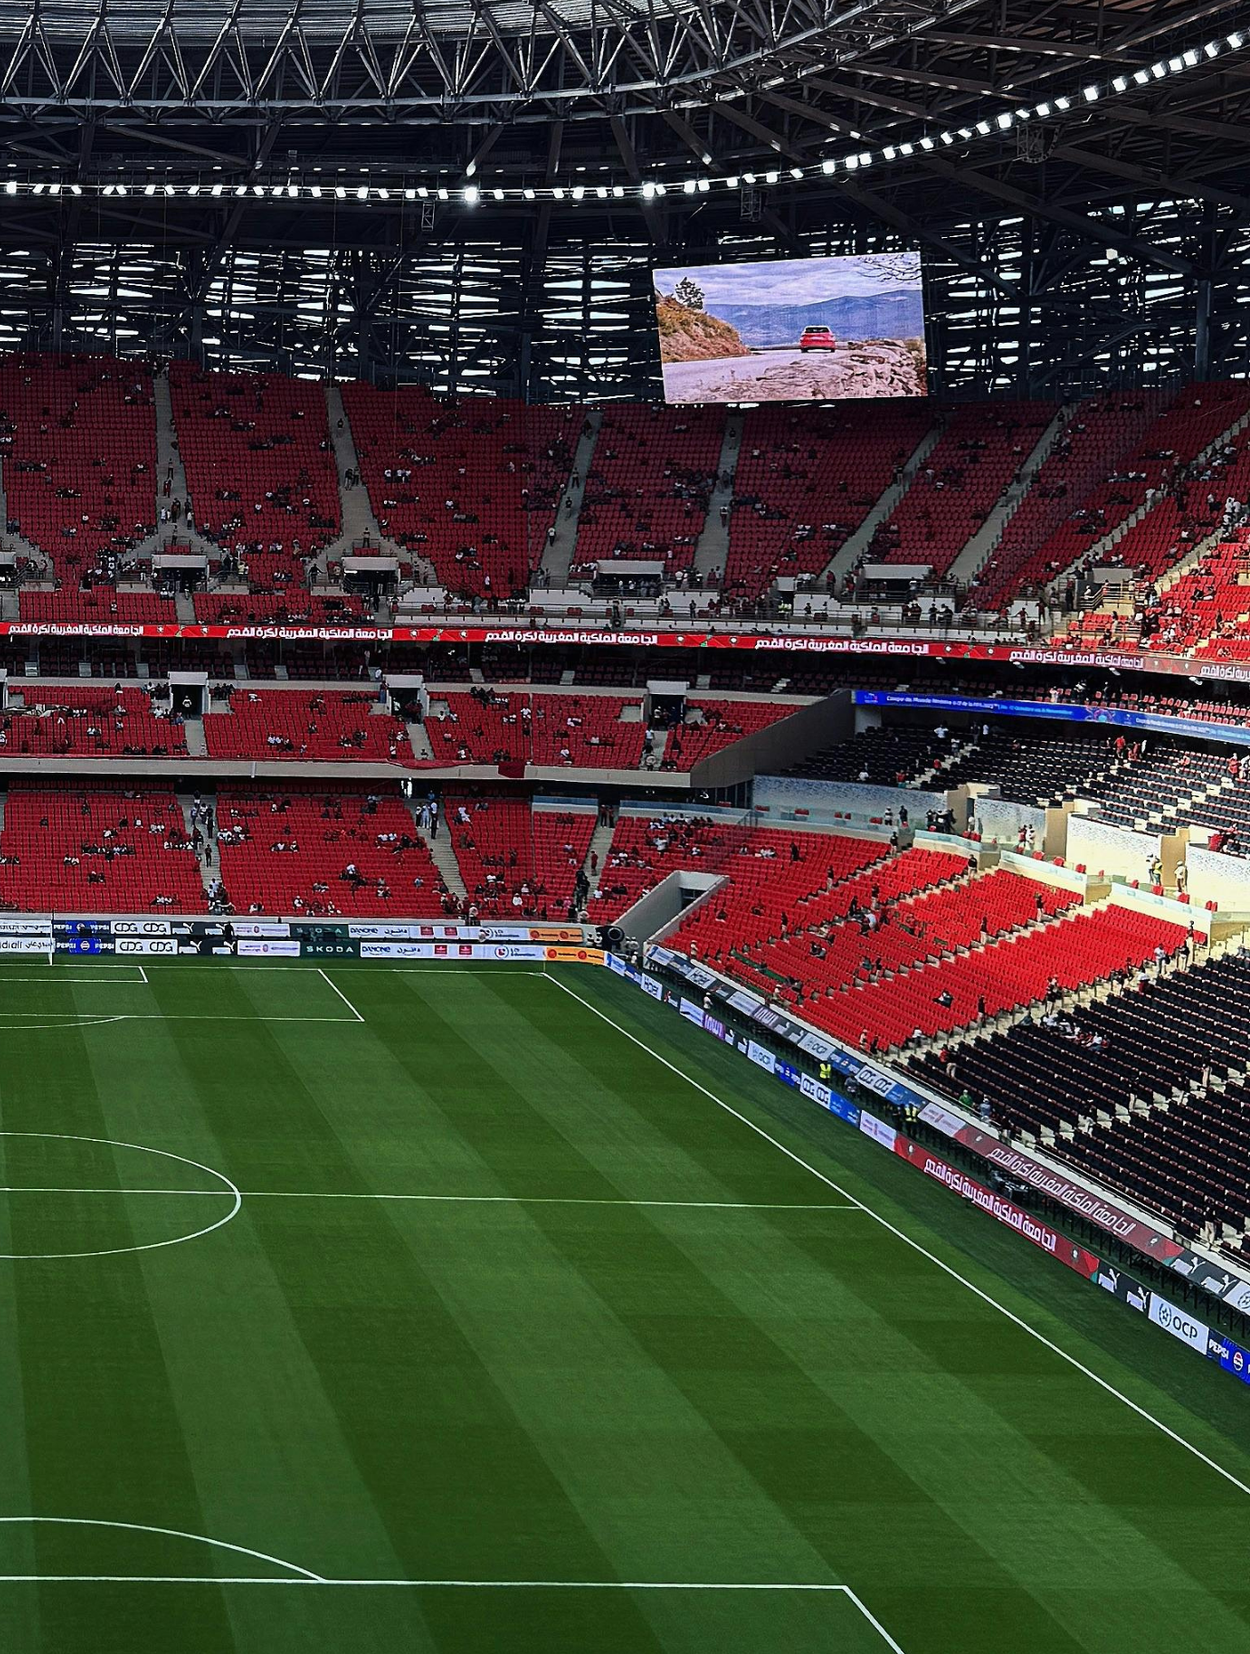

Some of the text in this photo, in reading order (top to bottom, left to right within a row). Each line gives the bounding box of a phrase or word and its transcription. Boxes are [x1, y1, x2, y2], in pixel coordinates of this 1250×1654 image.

[227, 627, 392, 640] الجامعة الملكية المغربية لكرة القدم
[485, 631, 657, 646] الجامعة الملكية المغربية لكرة القدم
[755, 638, 929, 656] الجامعة الملكية المغربية لكرة القدم
[114, 923, 137, 932] CDG
[144, 923, 167, 932] CDG
[120, 942, 142, 952] CDG
[150, 942, 173, 952] CDG
[986, 1148, 1136, 1236] الجامعة الملكية المغربية لكرة القدم
[924, 1159, 1056, 1251] الجامعة الملكية المغربية لكرة القدم
[1173, 1316, 1198, 1339] OCP
[1209, 1339, 1229, 1360] PEPSI
